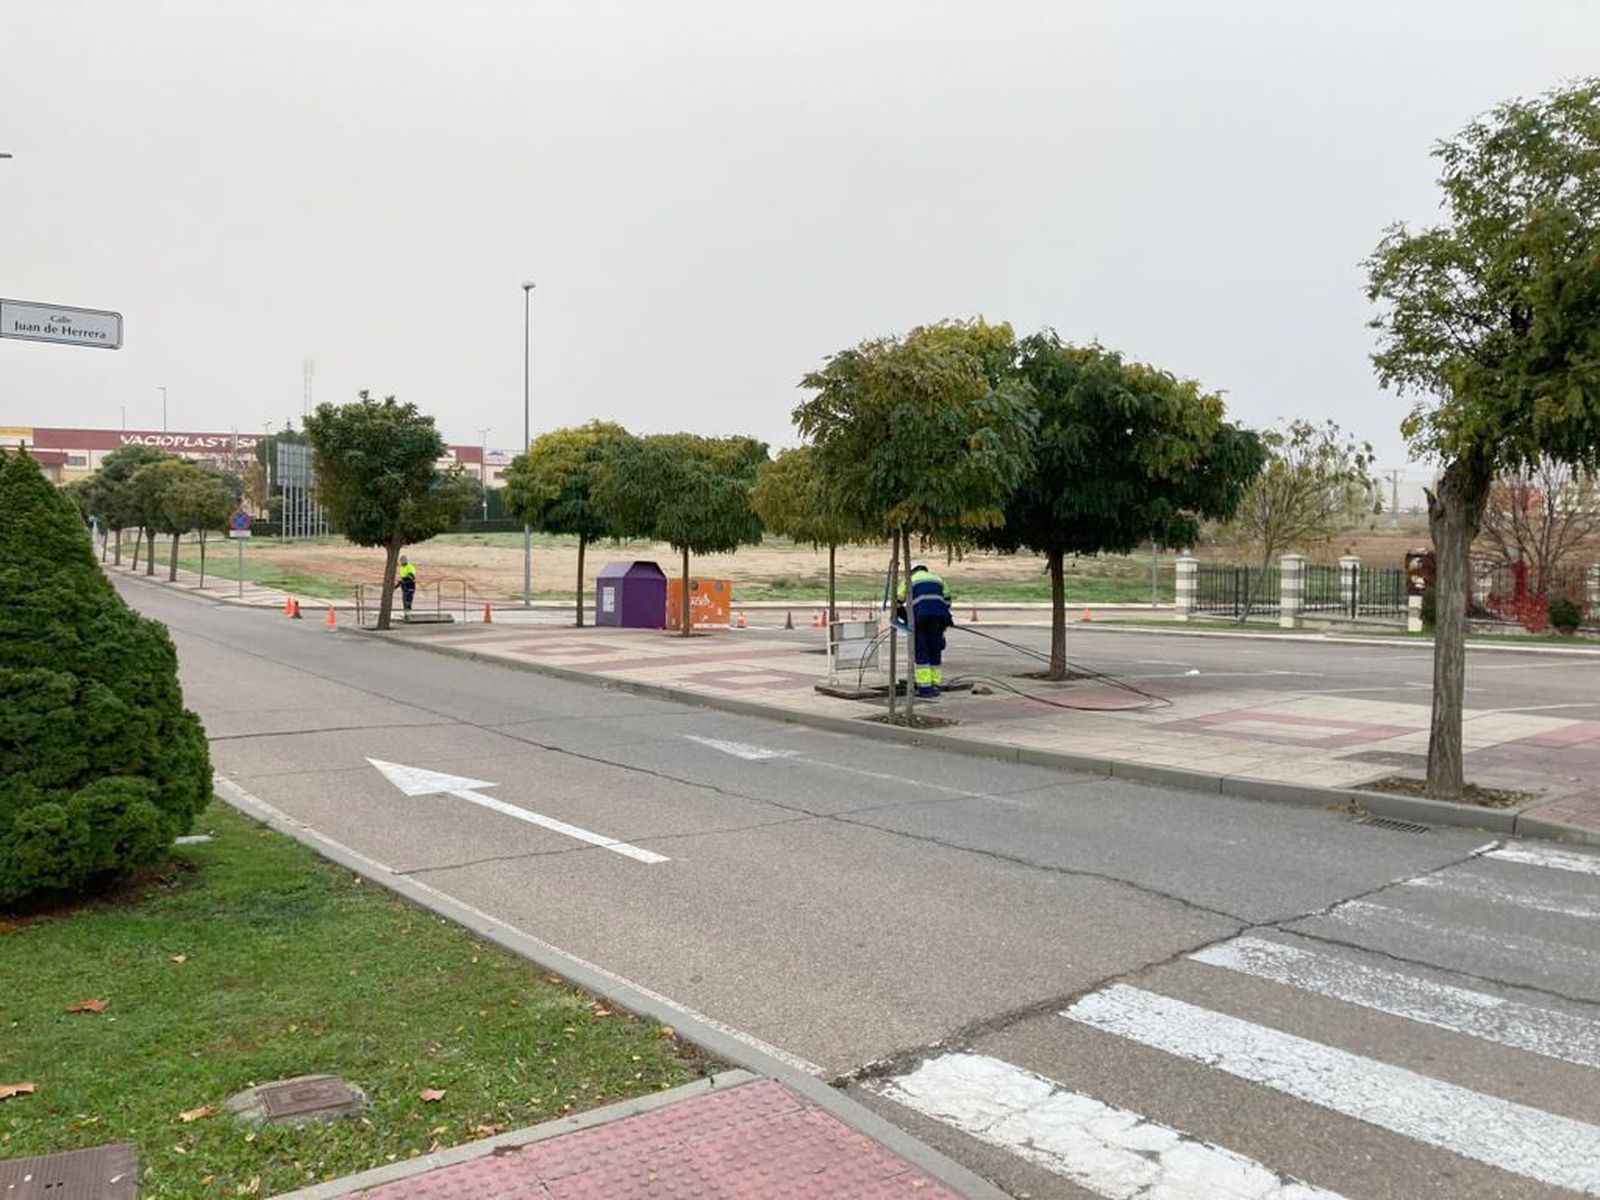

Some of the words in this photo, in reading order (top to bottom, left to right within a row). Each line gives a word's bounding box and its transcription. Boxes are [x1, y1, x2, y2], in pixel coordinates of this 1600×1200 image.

[50, 315, 72, 323] Calle
[14, 320, 40, 331] Juan
[44, 323, 58, 334] de
[62, 326, 106, 339] Herrera
[120, 434, 231, 447] VACIOPLAST
